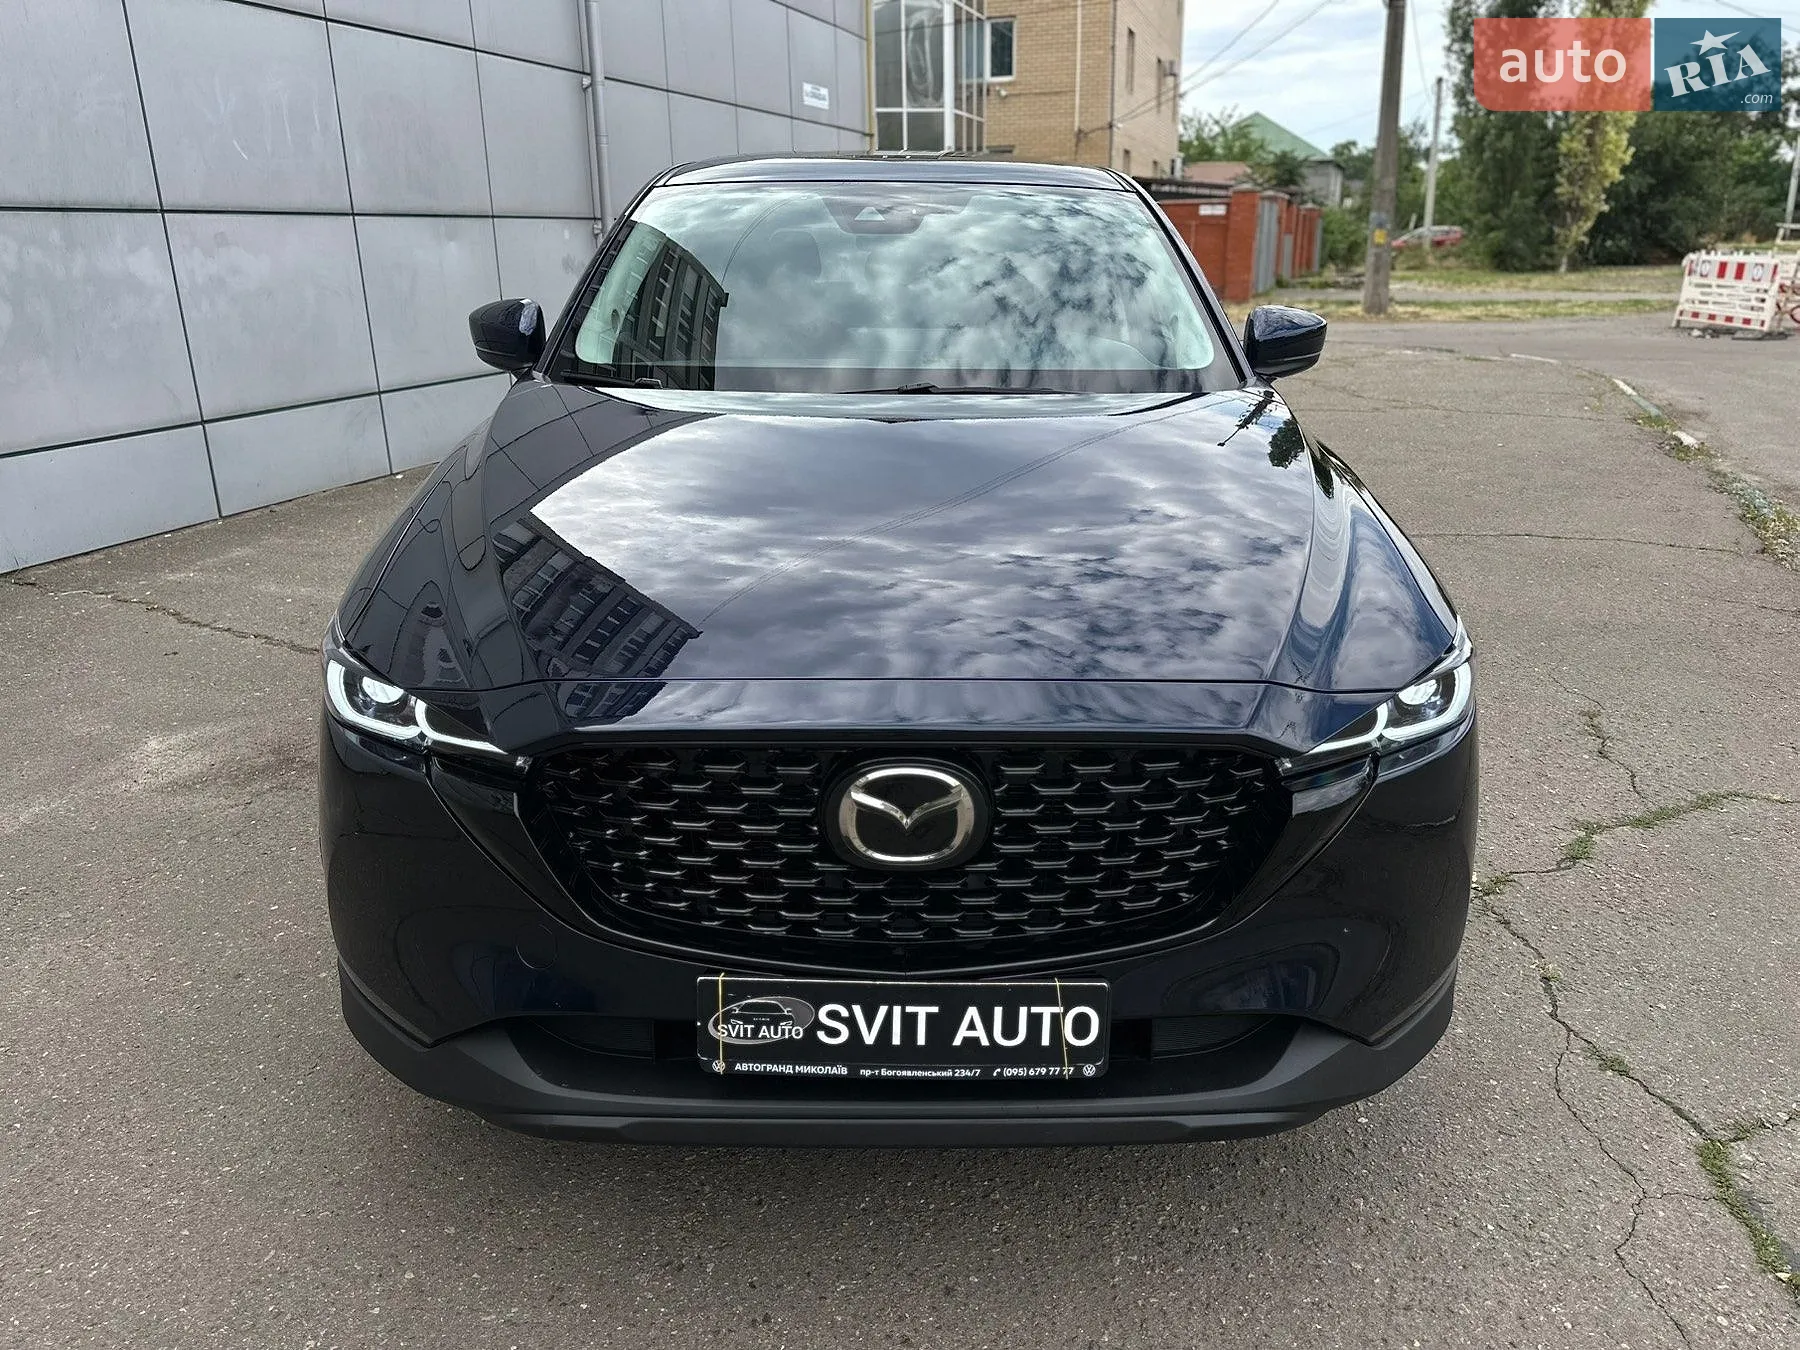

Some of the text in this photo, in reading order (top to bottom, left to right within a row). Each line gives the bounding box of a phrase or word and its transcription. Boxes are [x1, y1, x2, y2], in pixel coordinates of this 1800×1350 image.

[816, 1004, 1100, 1047] SVIT AUTO
[717, 1024, 804, 1040] SVIT AUTO
[735, 1063, 848, 1075] АВТОГРАНД МИКОЛАЇВ
[860, 1067, 981, 1078] пр-т Богоявленський 234/7
[1003, 1067, 1027, 1077] (095)
[1029, 1067, 1047, 1075] 679
[1049, 1067, 1060, 1075] 77
